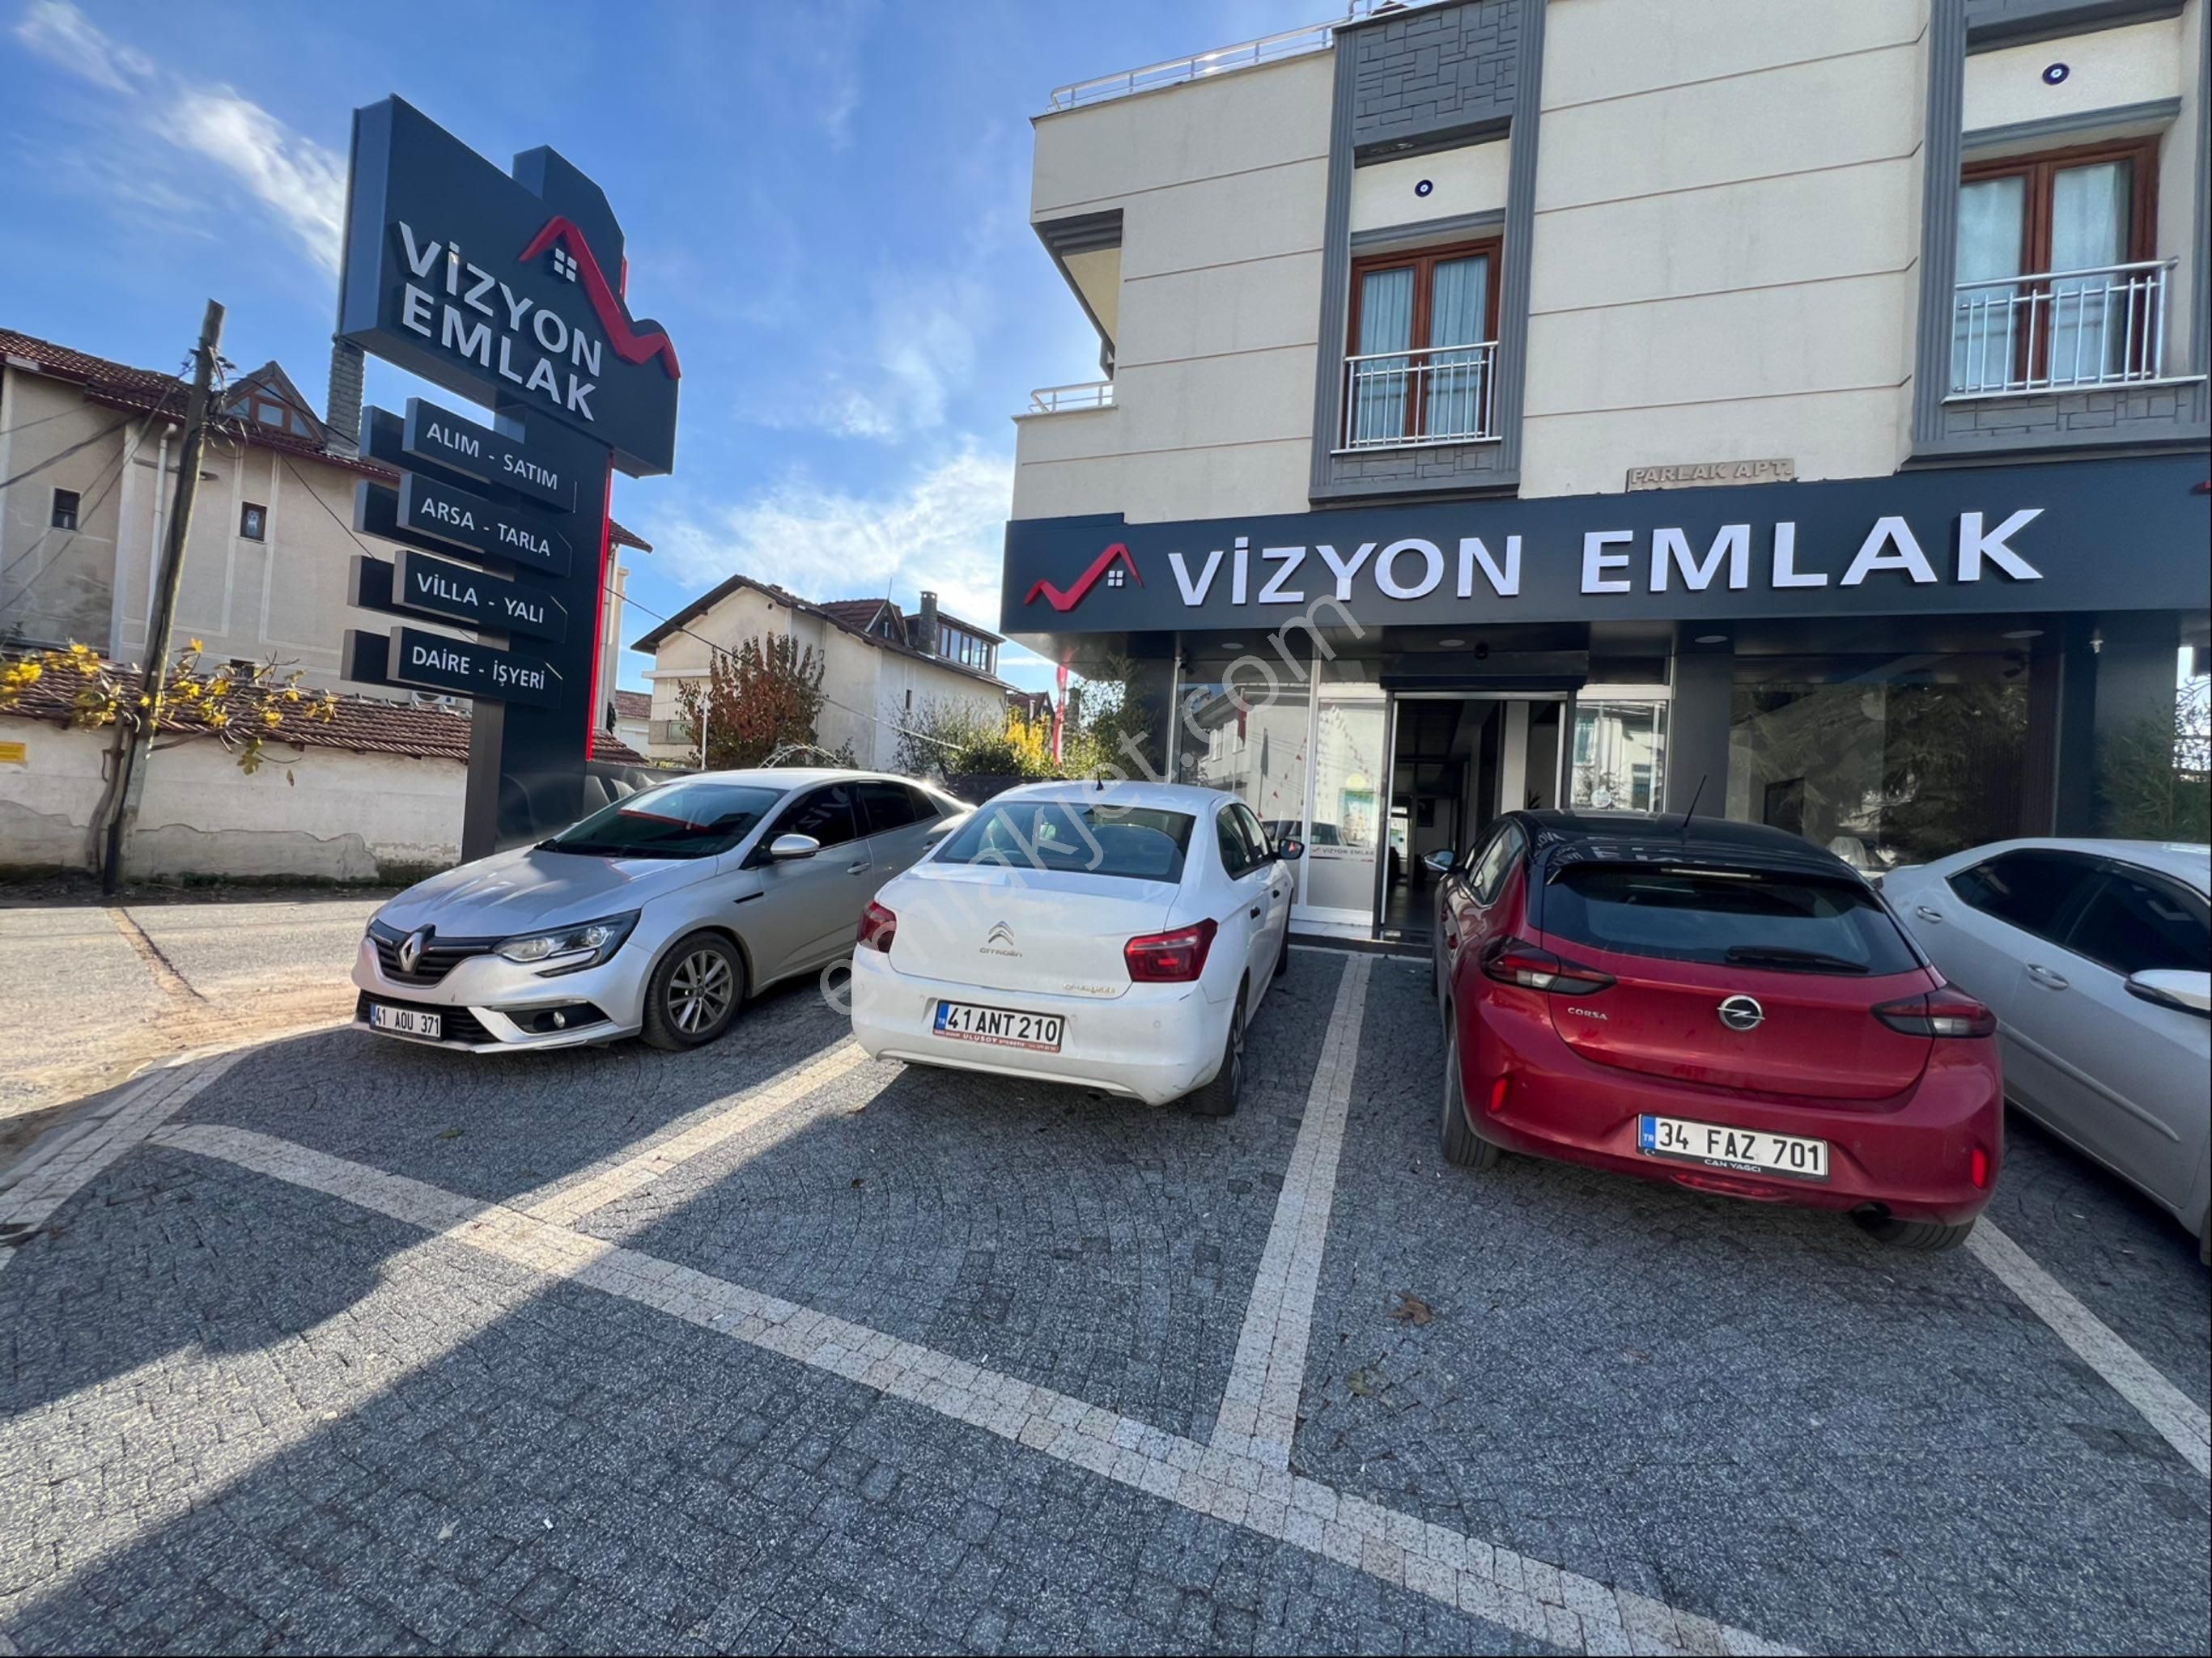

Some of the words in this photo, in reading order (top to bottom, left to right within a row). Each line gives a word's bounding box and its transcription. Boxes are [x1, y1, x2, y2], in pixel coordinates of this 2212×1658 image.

[399, 221, 601, 377] VİZYON
[403, 282, 596, 422] EMLAK
[427, 422, 479, 458] ALIM
[503, 454, 558, 490] SATIM
[1631, 464, 1727, 485] PARLAK
[1734, 461, 1793, 478] APT.
[421, 498, 474, 530] ARSA
[497, 523, 550, 557] TARLA
[1168, 535, 1522, 606] VİZYON
[1581, 508, 2044, 594] EMLAK
[417, 573, 478, 606] VİLLA
[504, 597, 543, 624] YALI
[412, 647, 470, 675] DAİRE
[493, 659, 546, 689] İŞYERİ
[376, 1007, 385, 1025] 41
[421, 1015, 439, 1035] 371
[948, 1007, 971, 1031] 41
[975, 1011, 1015, 1036] ANT
[1017, 1016, 1057, 1041] 210
[1568, 1007, 1608, 1020] CORSA
[963, 1033, 997, 1043] ULUSOY
[1643, 1133, 1654, 1143] TR
[1659, 1122, 1689, 1150] 34
[1708, 1130, 1756, 1160] FAZ
[1773, 1139, 1818, 1170] 701
[1704, 1159, 1727, 1168] CAN
